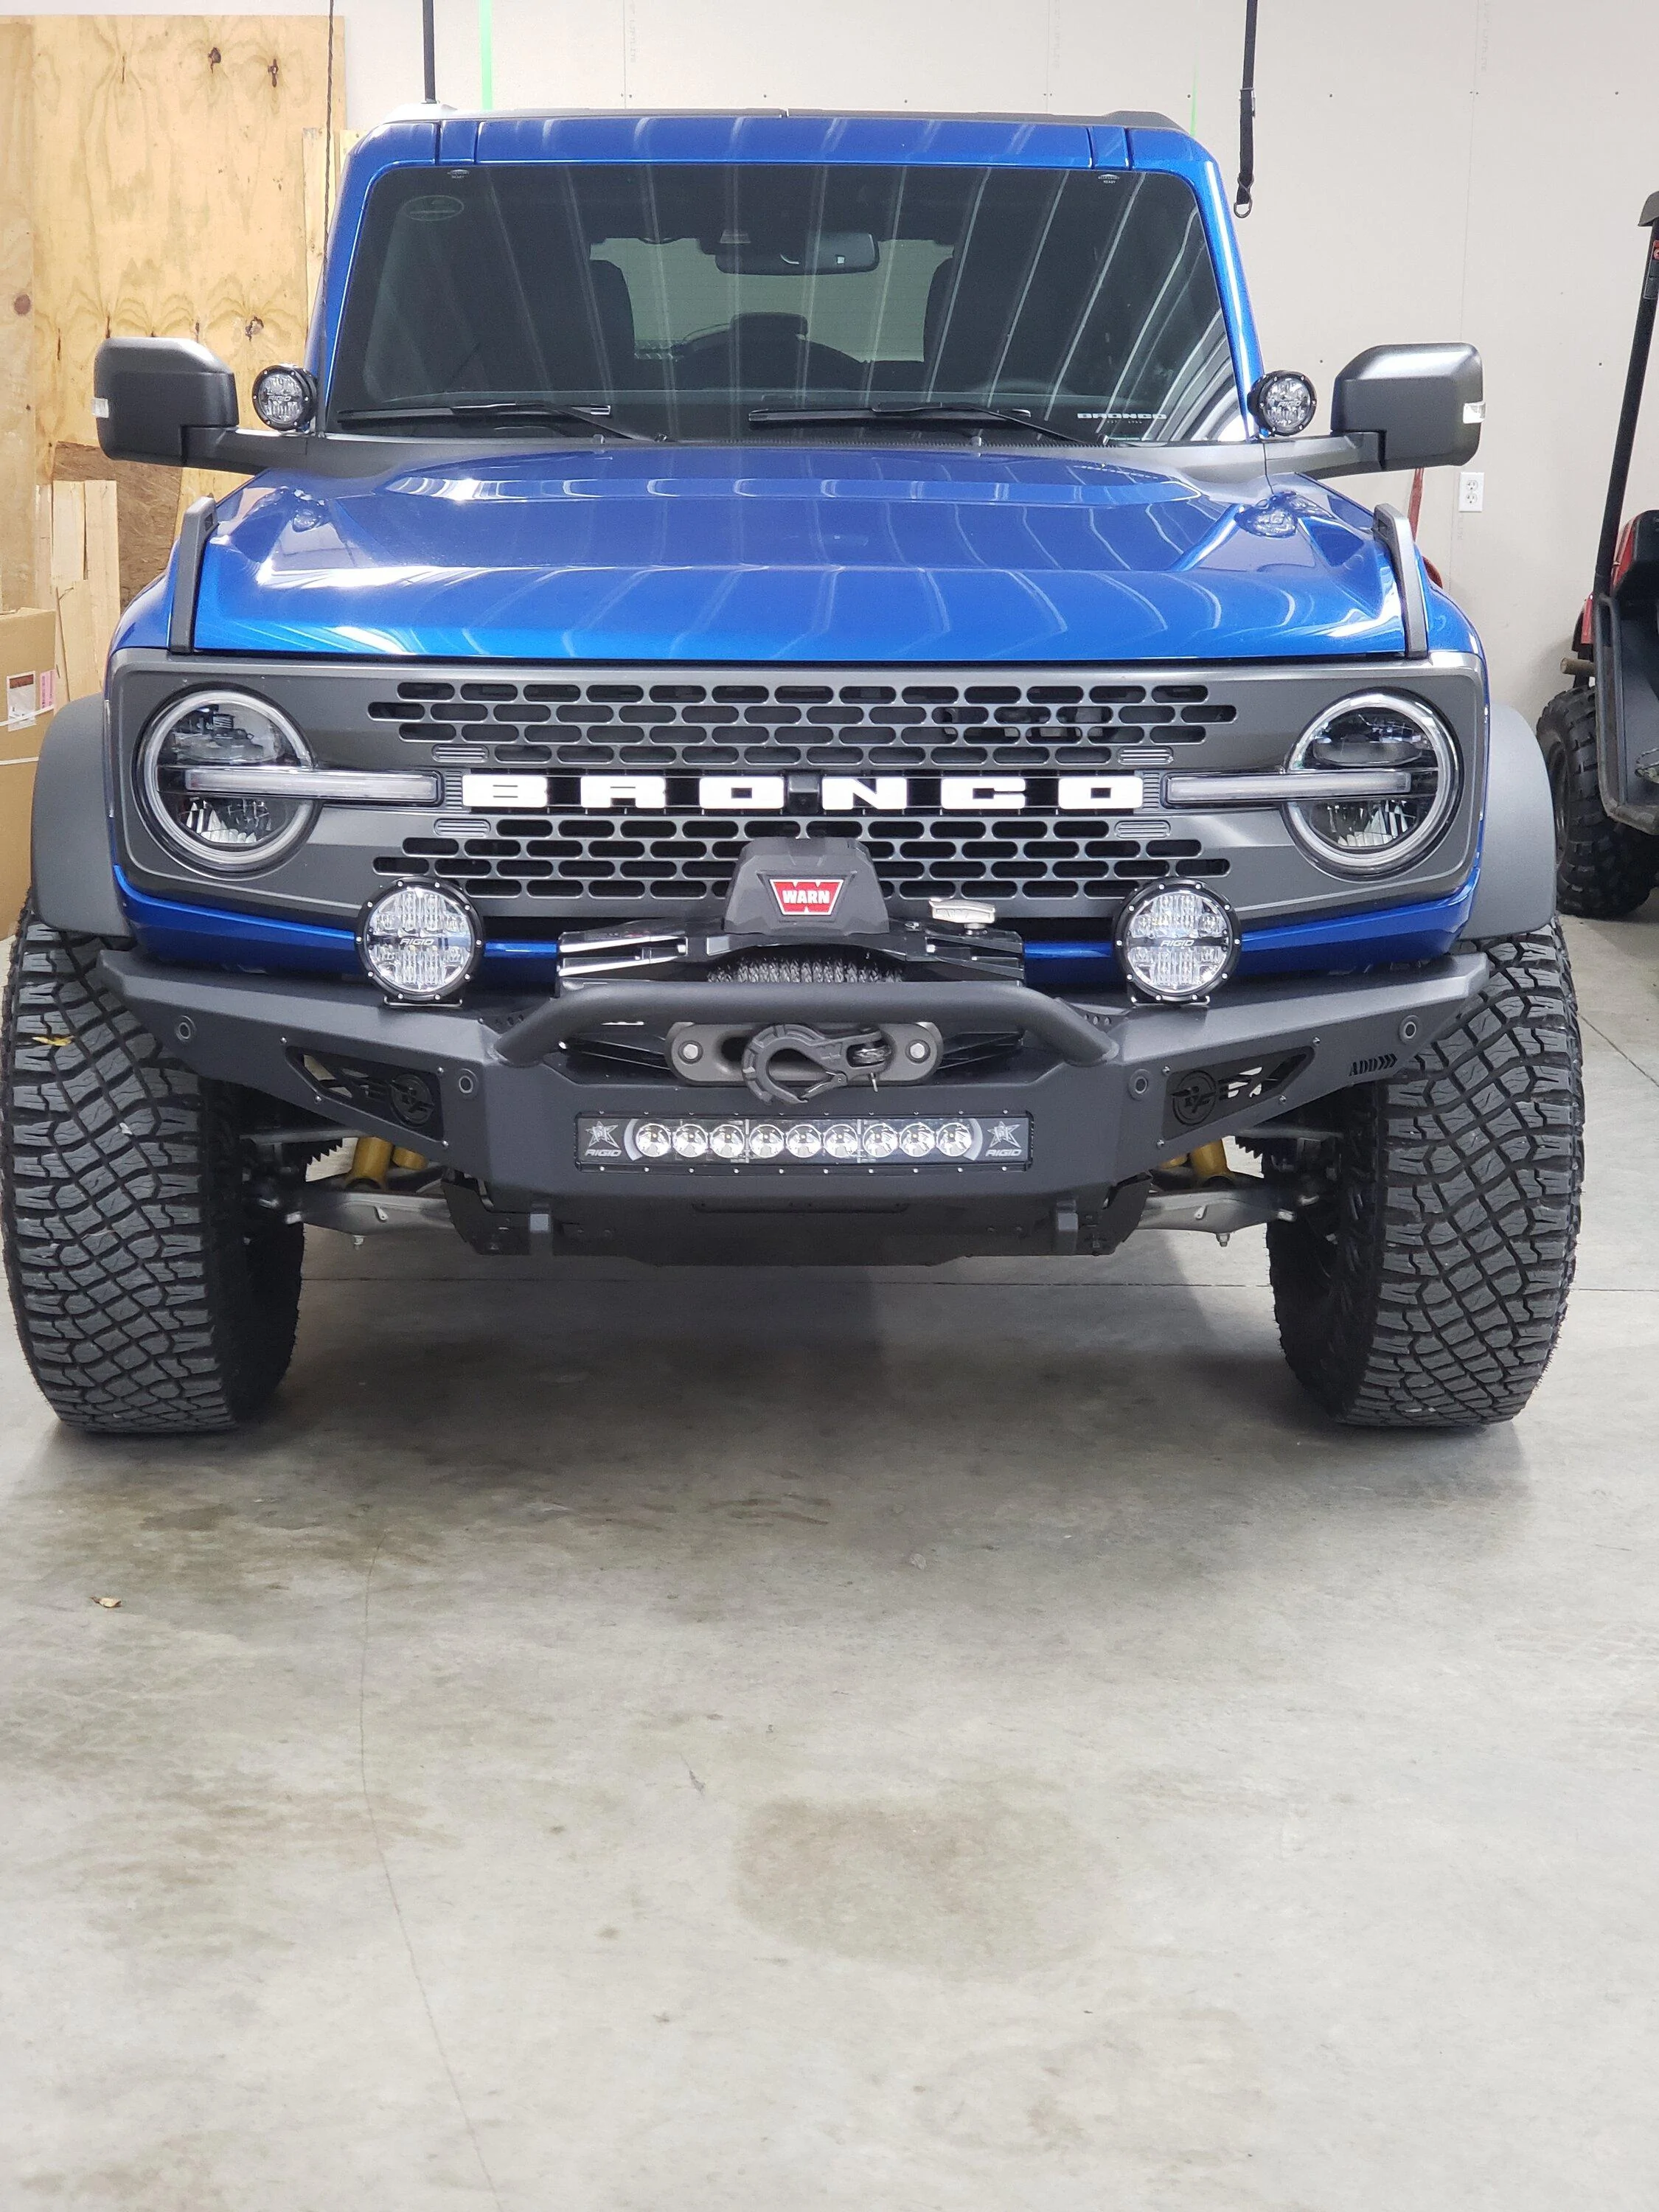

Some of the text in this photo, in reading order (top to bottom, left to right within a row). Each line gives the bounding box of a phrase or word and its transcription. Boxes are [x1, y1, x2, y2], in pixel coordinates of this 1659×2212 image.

[462, 775, 1144, 810] BRONCO
[782, 890, 830, 904] WARN
[585, 1149, 622, 1157] RIGID
[985, 1149, 1022, 1157] RIGID
